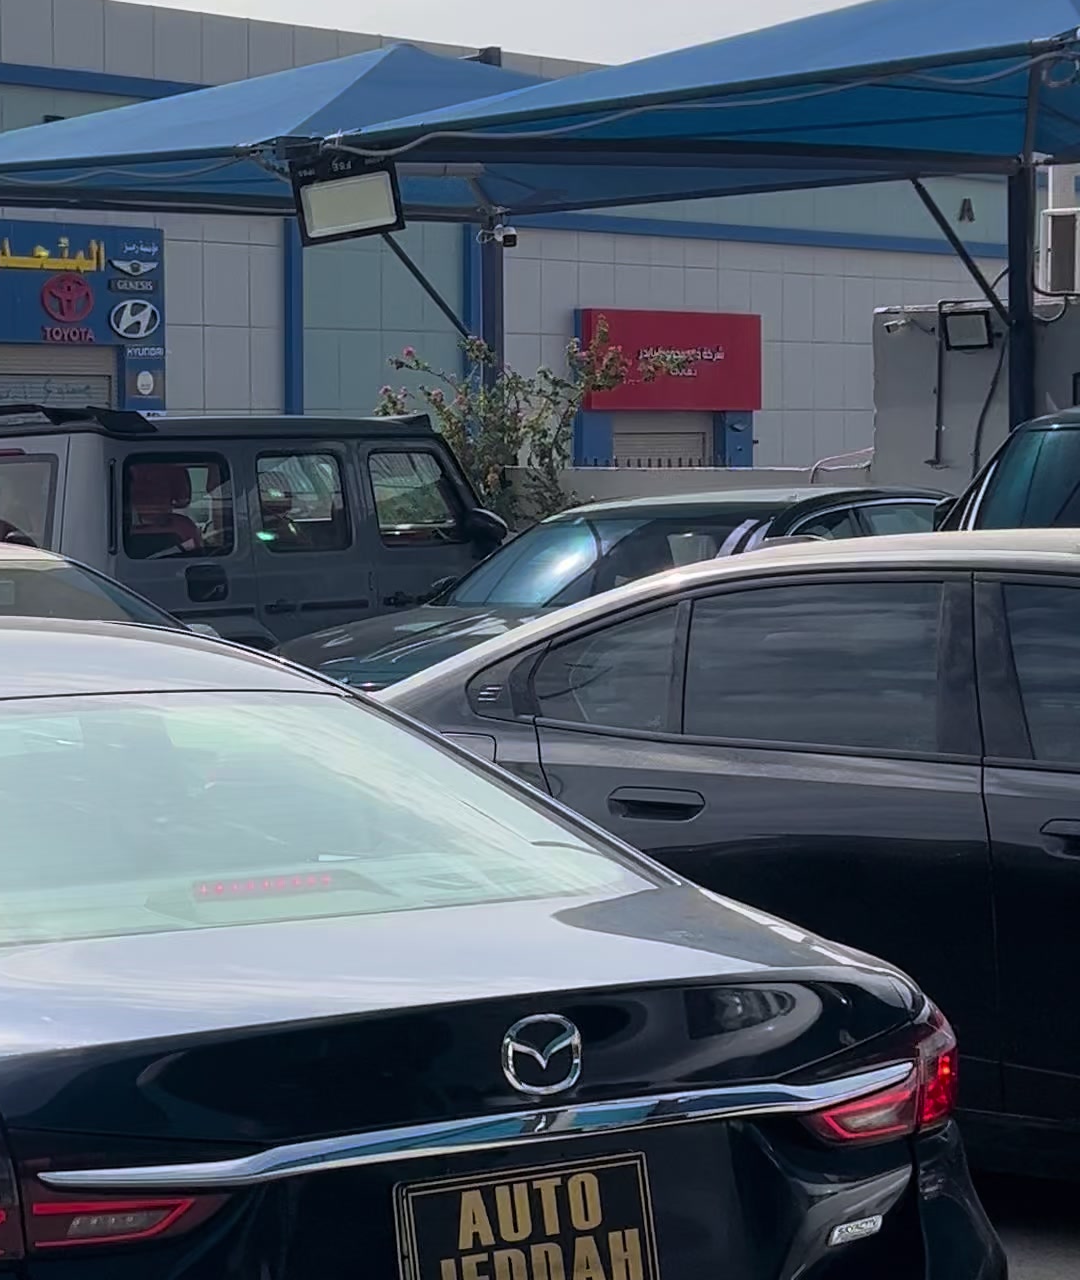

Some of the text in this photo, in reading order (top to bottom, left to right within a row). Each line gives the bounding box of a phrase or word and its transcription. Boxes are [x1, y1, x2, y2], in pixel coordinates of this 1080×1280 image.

[959, 198, 975, 222] A
[116, 279, 153, 291] GENESIS
[44, 326, 95, 342] TOYOTA
[126, 346, 164, 357] HYUNDAI
[458, 1173, 602, 1250] AUTO
